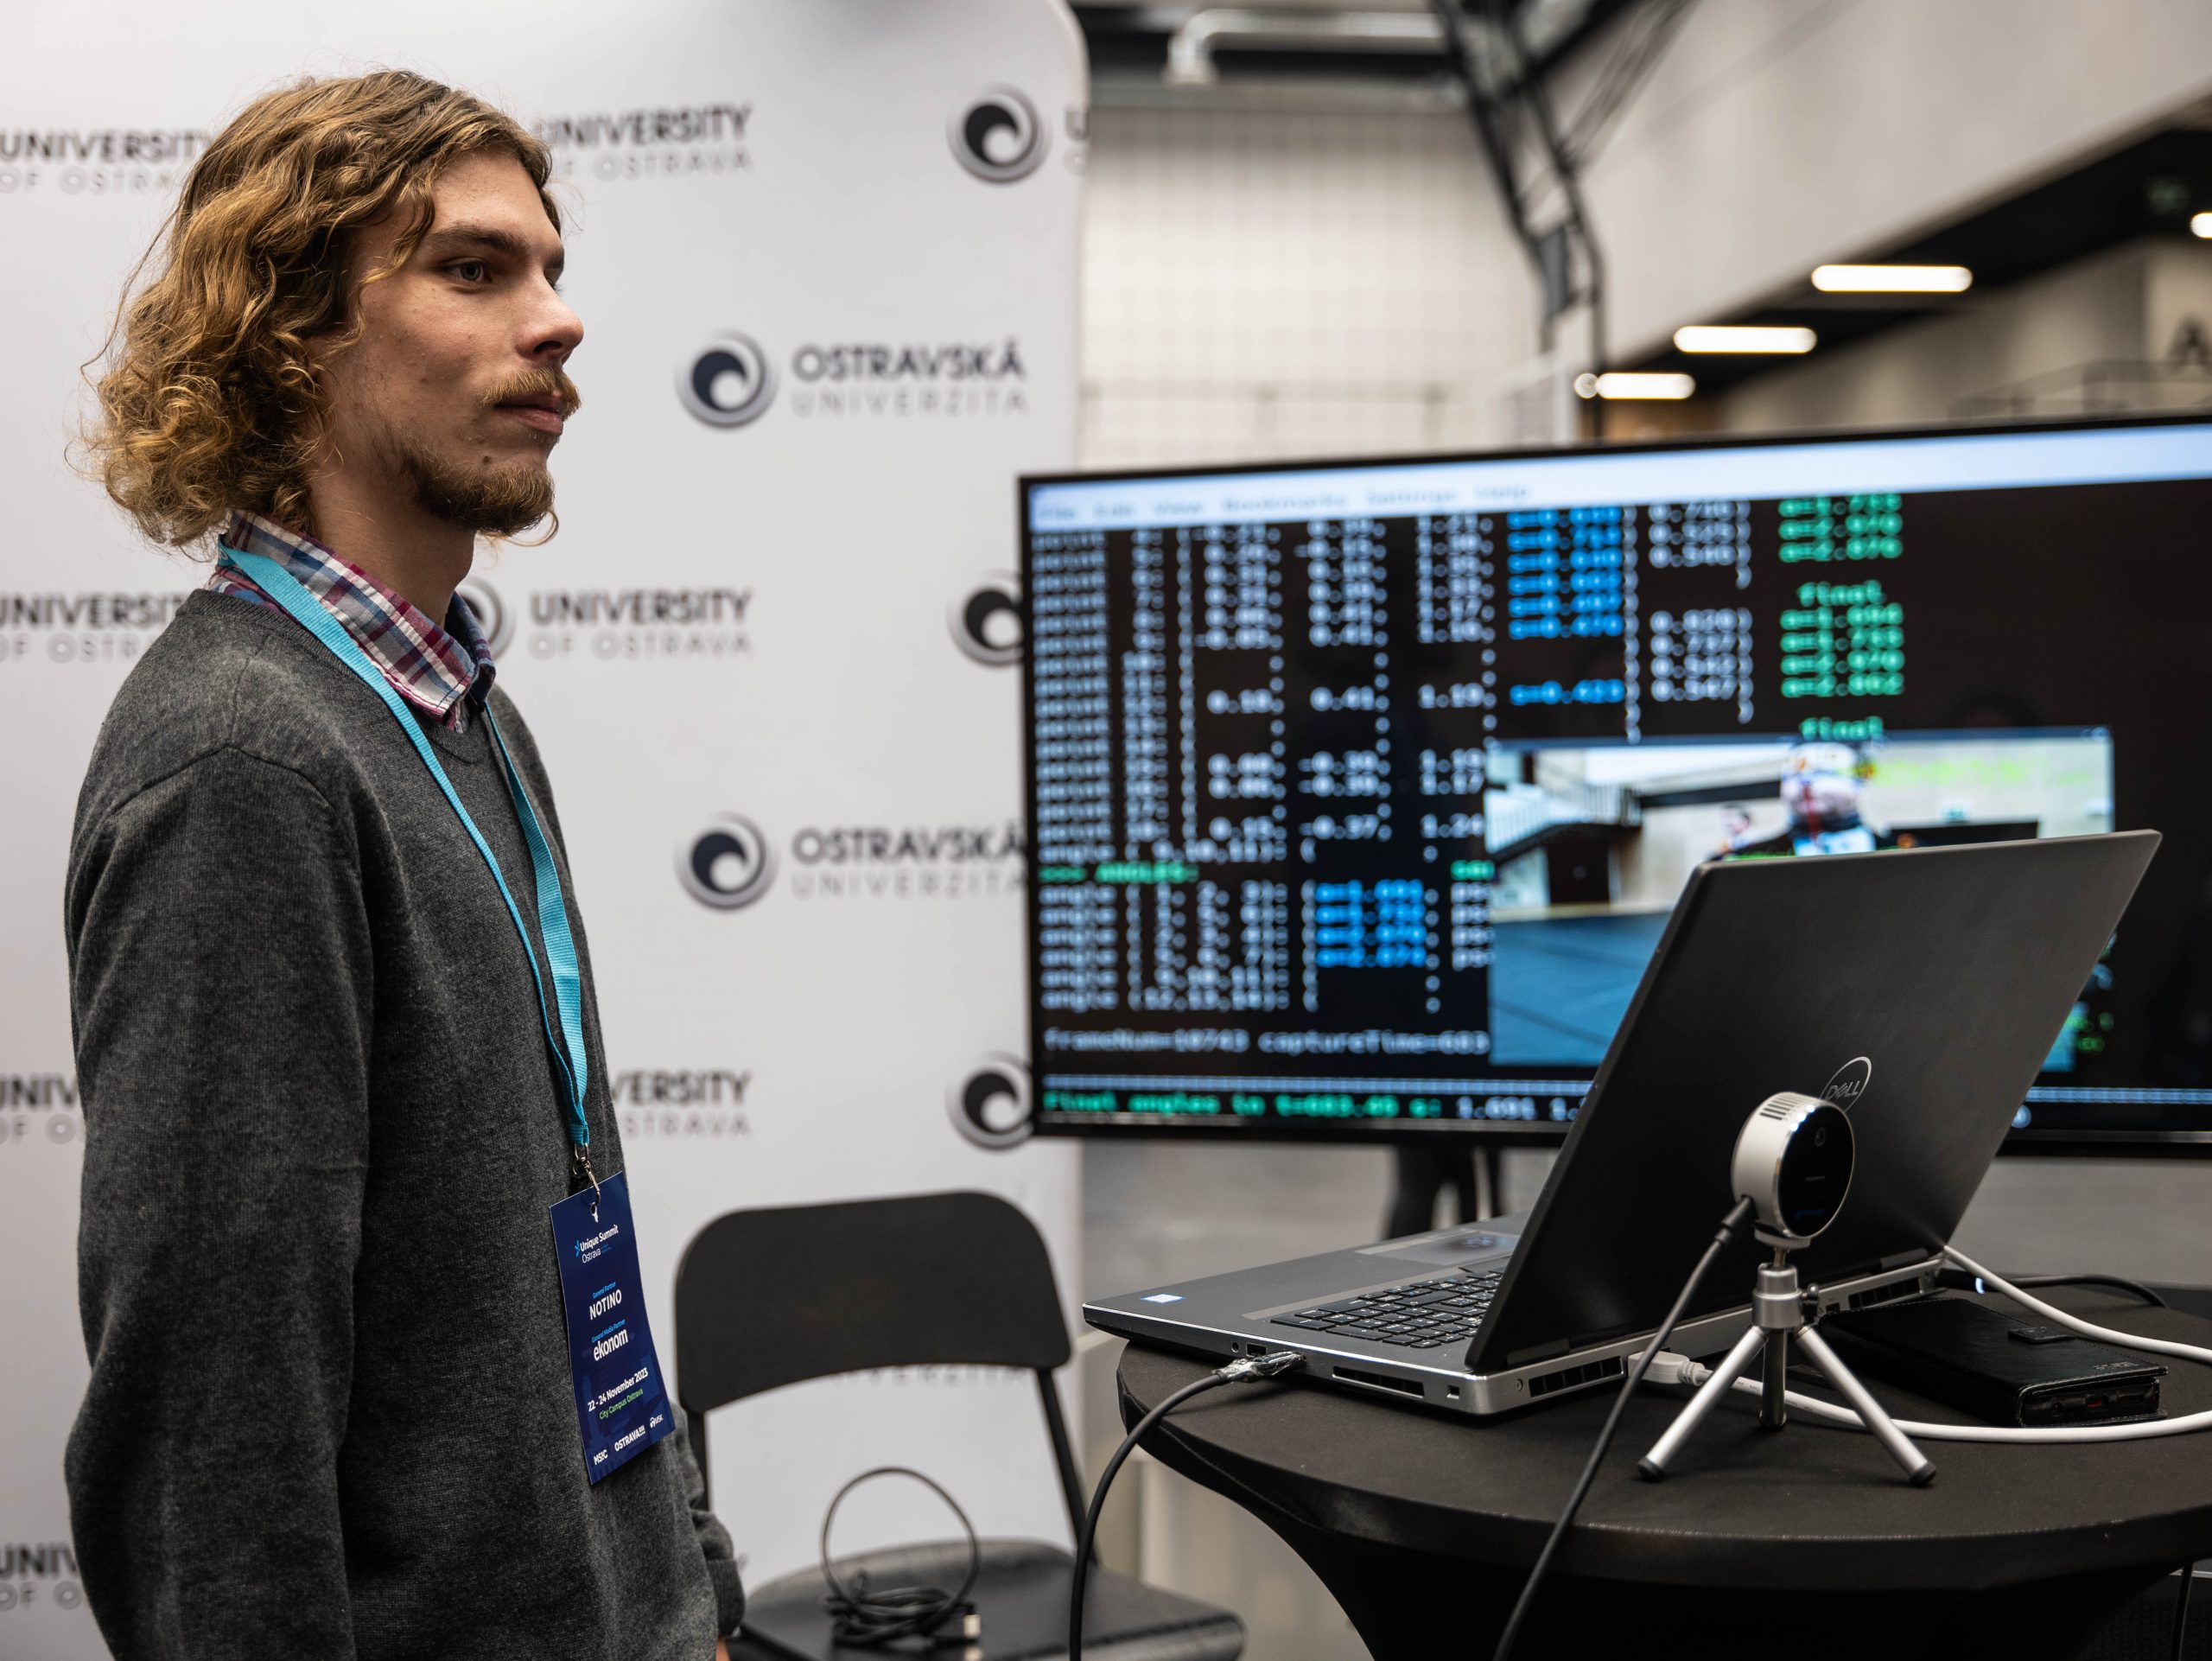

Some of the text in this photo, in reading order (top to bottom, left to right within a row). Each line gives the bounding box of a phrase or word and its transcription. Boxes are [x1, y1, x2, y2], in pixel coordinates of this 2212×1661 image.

[534, 101, 753, 147] NIVERSITY
[792, 336, 1027, 382] OSTRAVSKÁ
[531, 587, 754, 627] UNIVERSITY
[527, 628, 755, 662] OF OSTRAVA
[1825, 1080, 1860, 1101] DELL
[580, 1237, 599, 1251] Unique
[599, 1225, 619, 1242] Summit
[582, 1248, 601, 1263] Ostrava
[589, 1289, 622, 1321] NOTINO
[594, 1329, 628, 1361] ekonom
[588, 1399, 596, 1412] 22
[599, 1393, 607, 1405] 24
[607, 1378, 635, 1400] November
[634, 1366, 649, 1383] 2023
[599, 1388, 644, 1420] City Campus Ostrava
[614, 1425, 646, 1452] OSTRAVA!!!
